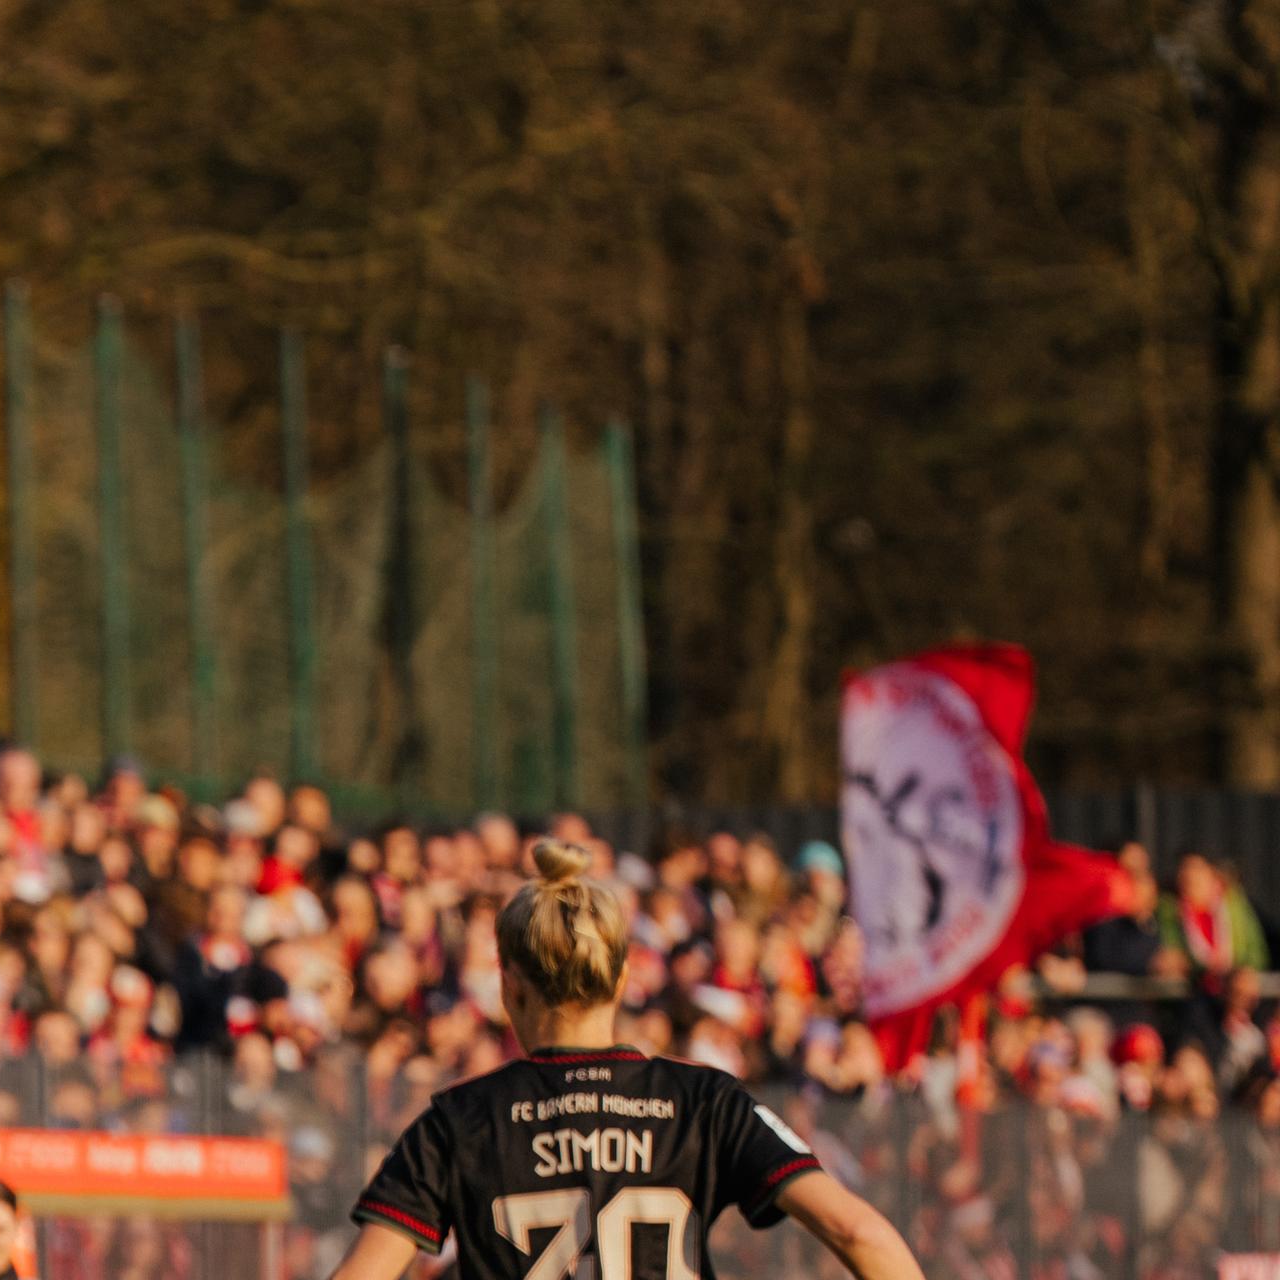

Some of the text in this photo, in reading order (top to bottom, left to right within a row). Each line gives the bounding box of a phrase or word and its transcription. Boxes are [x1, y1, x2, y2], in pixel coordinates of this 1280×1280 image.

[511, 1101, 534, 1123] FC
[537, 1092, 598, 1121] BAYERN
[532, 1127, 653, 1178] SIMON
